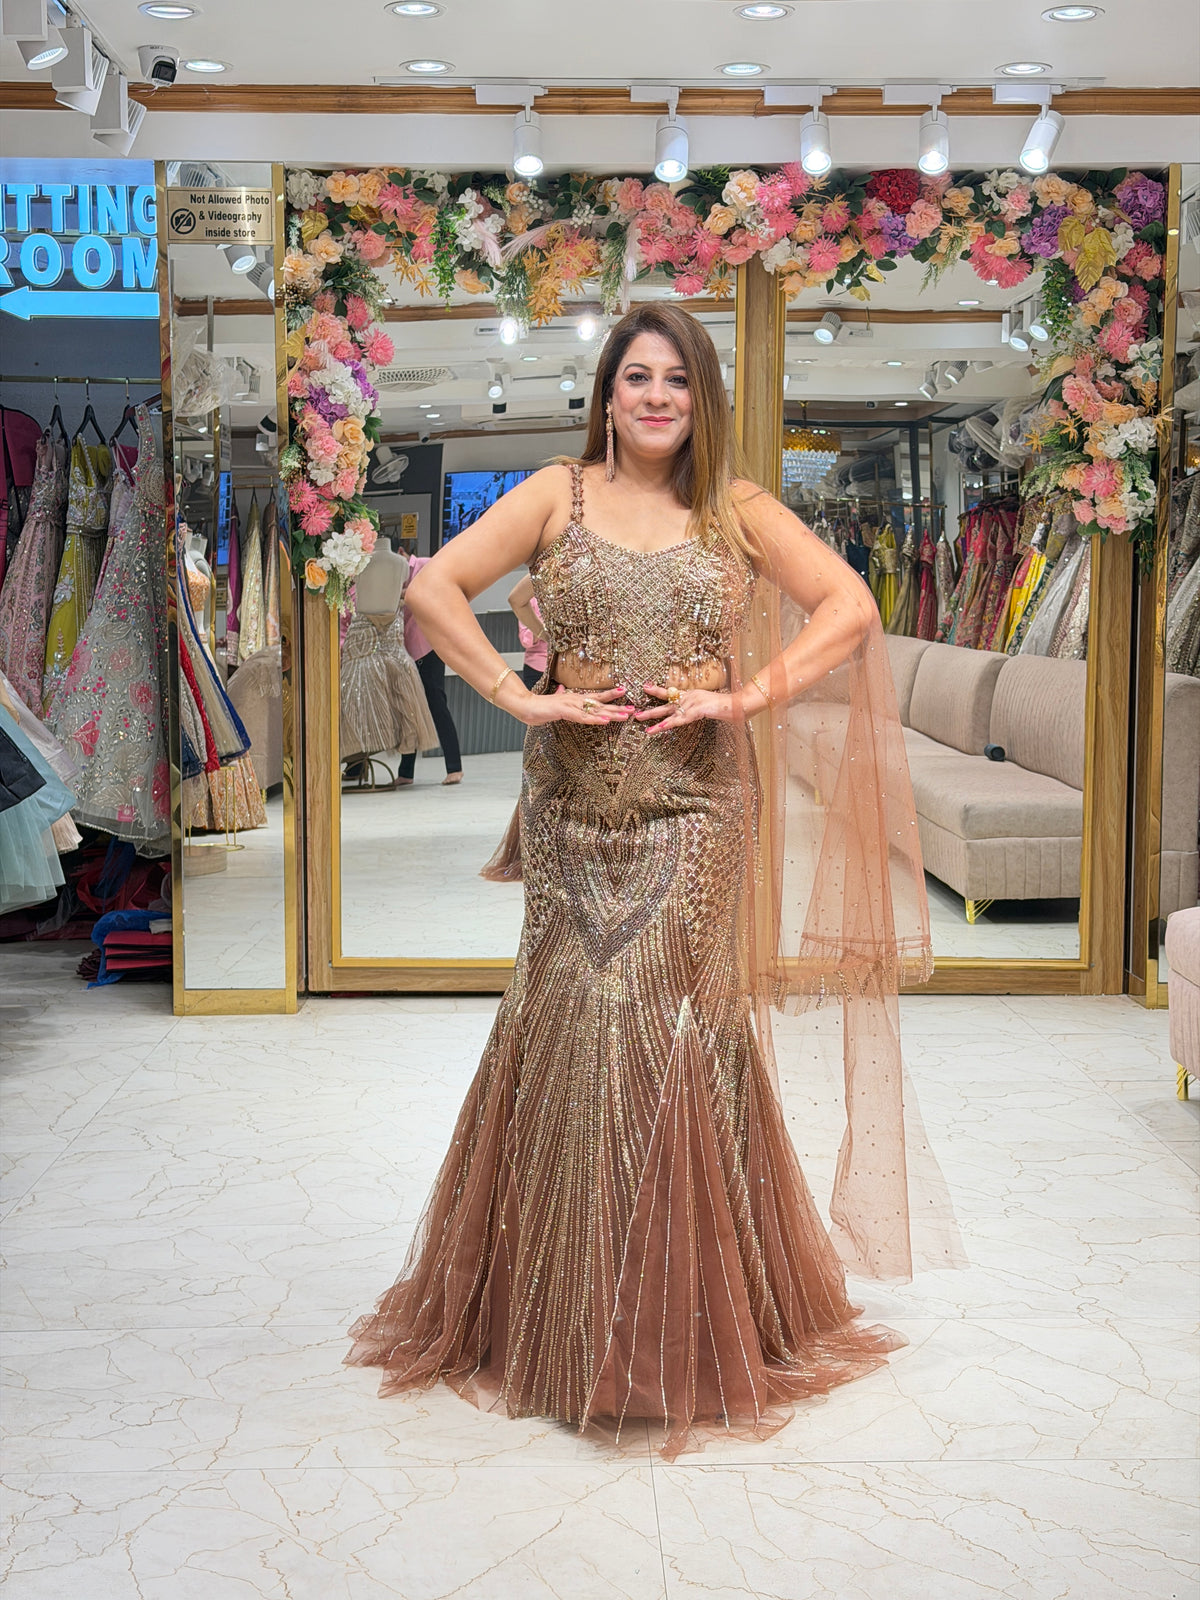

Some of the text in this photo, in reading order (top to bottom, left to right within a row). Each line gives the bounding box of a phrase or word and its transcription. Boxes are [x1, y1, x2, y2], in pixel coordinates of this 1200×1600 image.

[190, 194, 270, 205] Not Allowed Photo
[0, 184, 157, 235] TTING
[199, 211, 262, 223] & Videography
[205, 227, 256, 238] inside store
